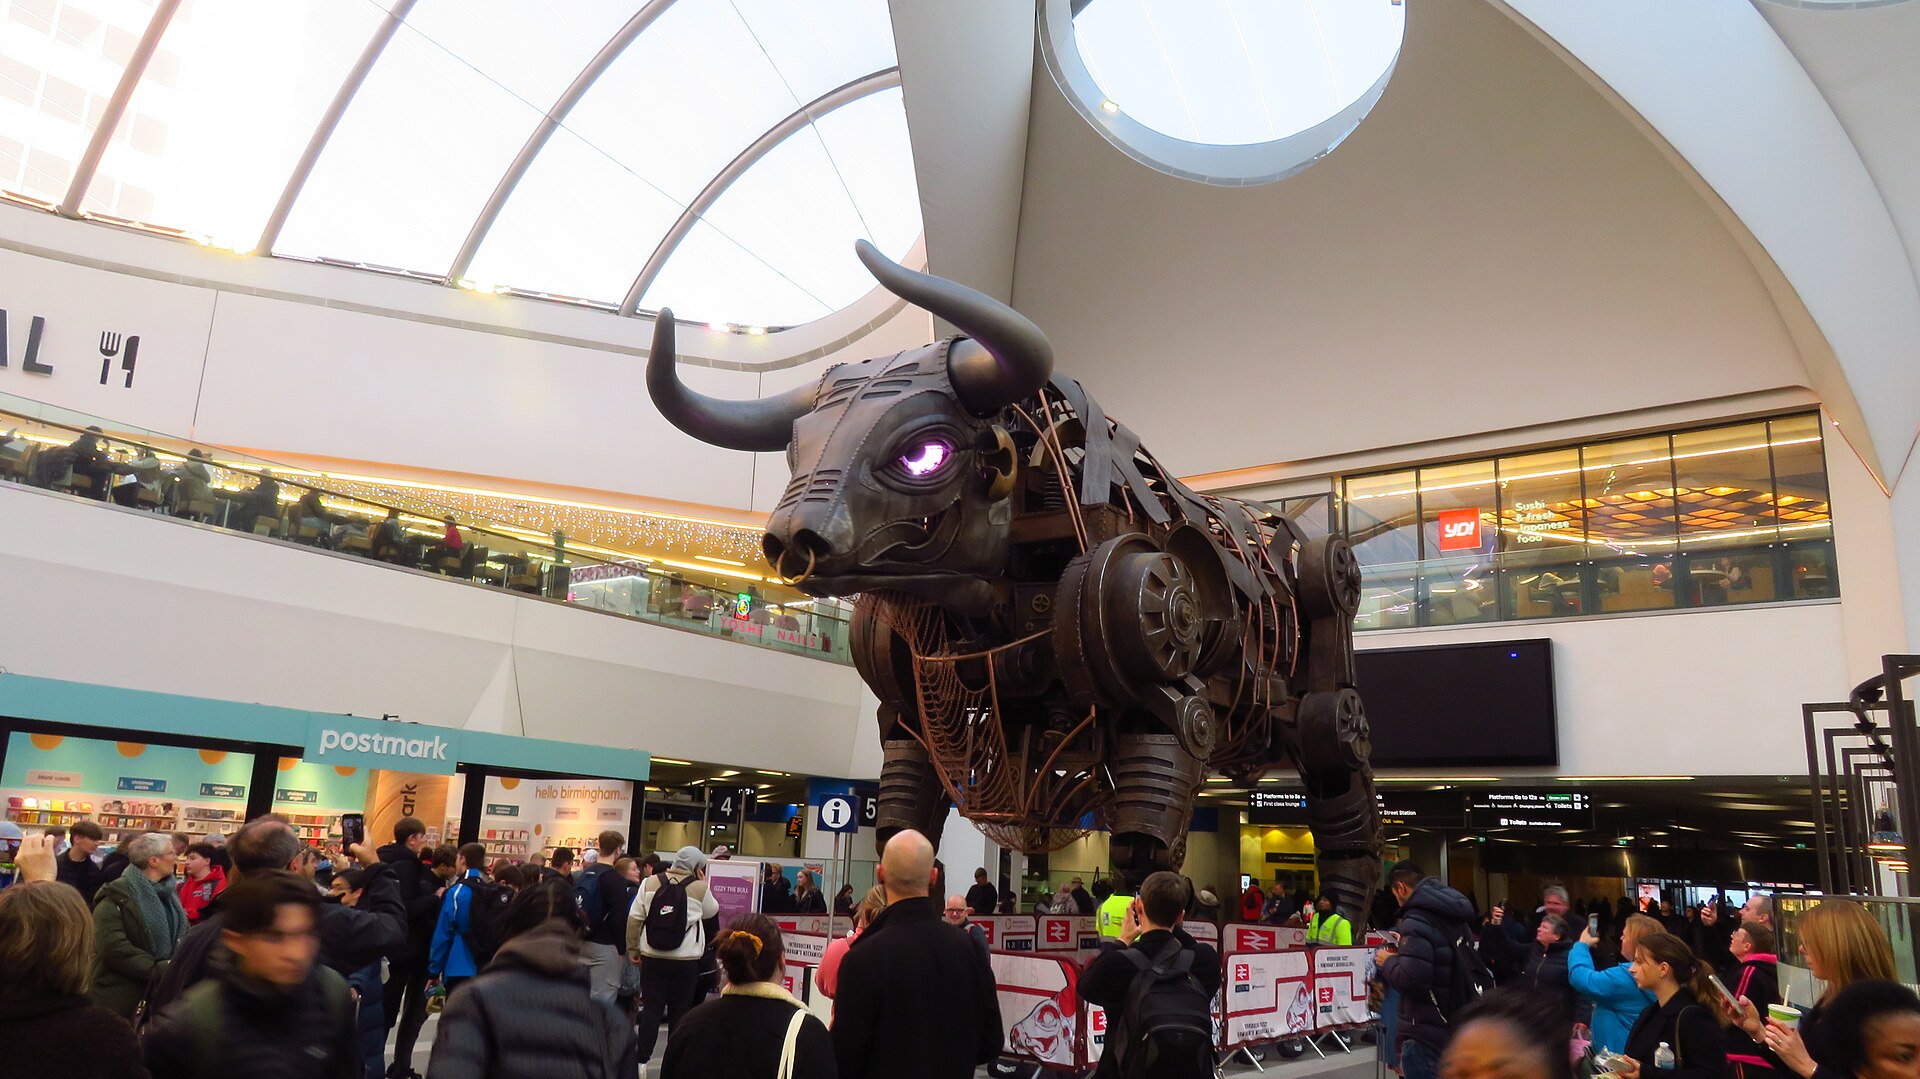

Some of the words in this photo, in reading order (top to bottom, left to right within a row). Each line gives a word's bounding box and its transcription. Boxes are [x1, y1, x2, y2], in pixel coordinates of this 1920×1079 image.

[0, 308, 54, 376] L
[1515, 500, 1546, 512] Sushi
[1526, 510, 1556, 521] fresh
[1444, 521, 1475, 538] YO!
[777, 630, 817, 648] NAILS
[319, 729, 449, 761] postmark
[535, 786, 559, 799] hello
[720, 796, 733, 817] 4
[865, 797, 876, 819] 5
